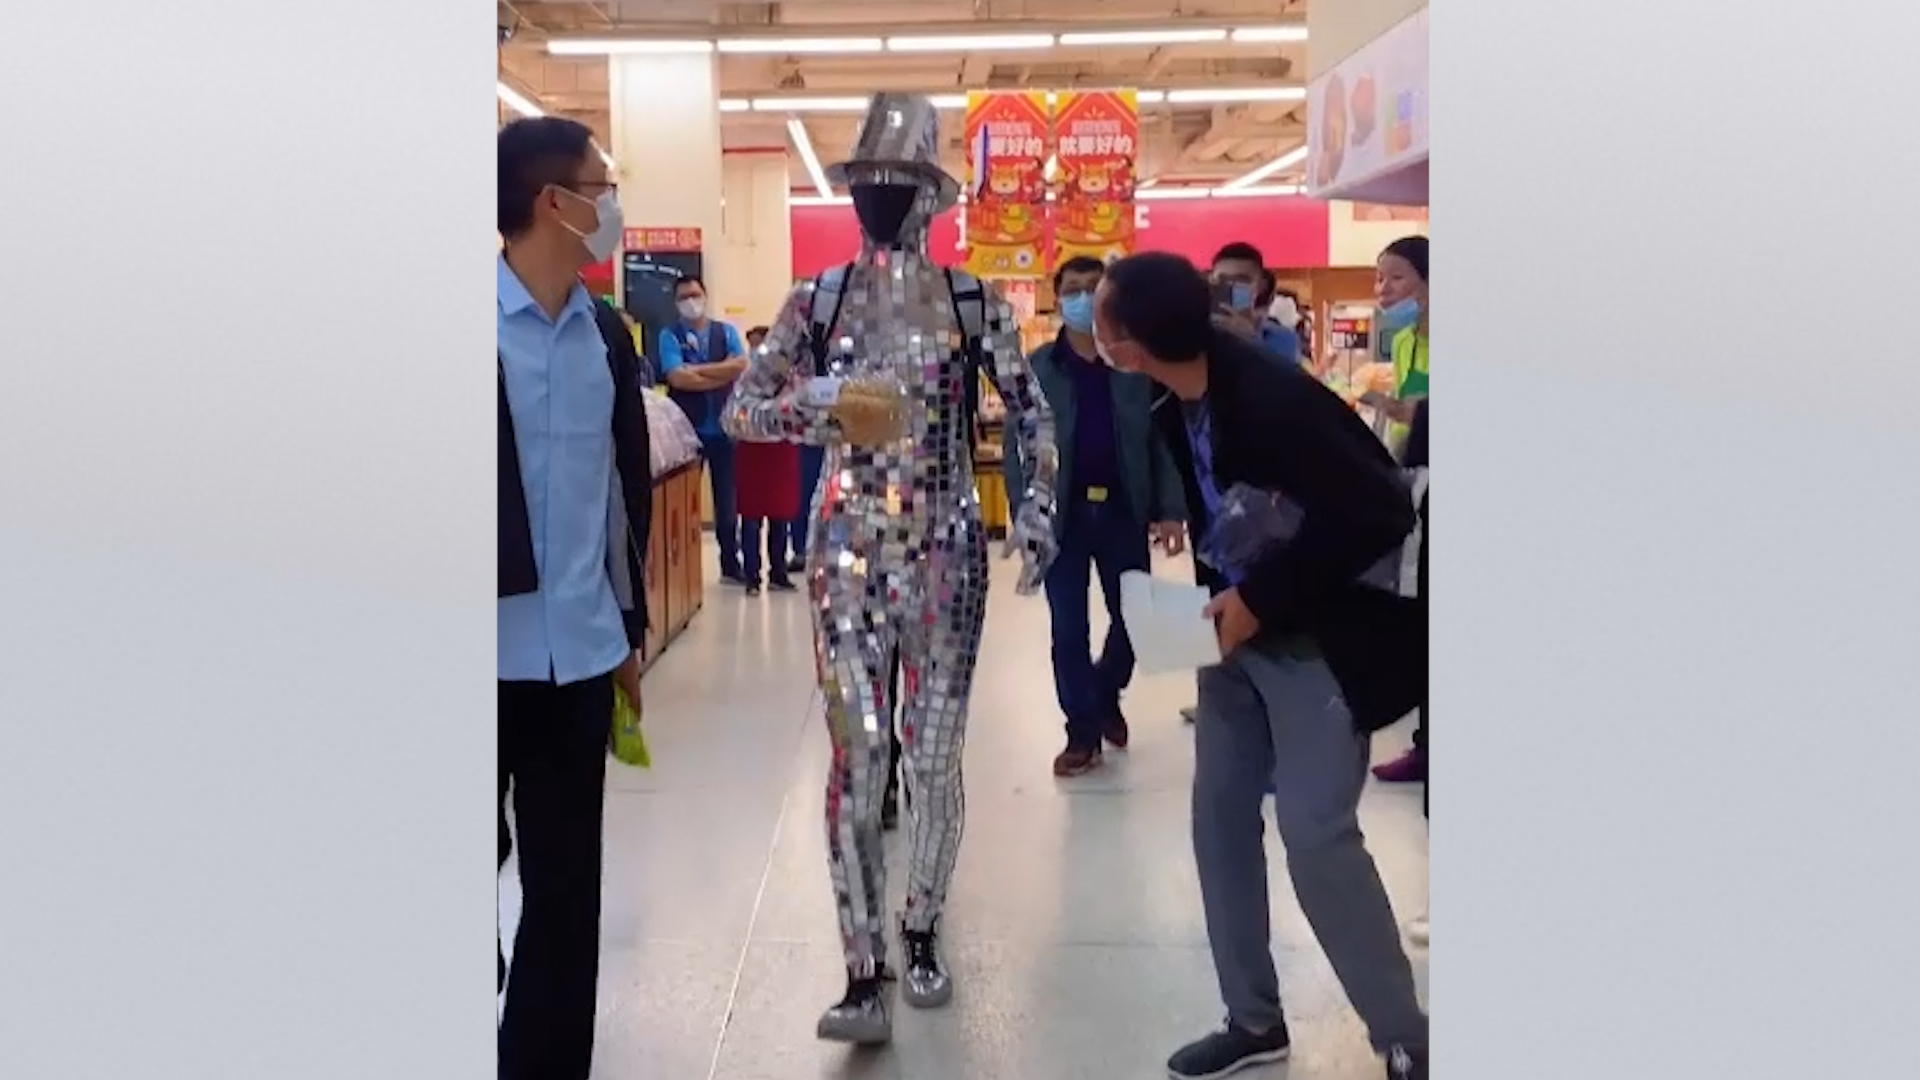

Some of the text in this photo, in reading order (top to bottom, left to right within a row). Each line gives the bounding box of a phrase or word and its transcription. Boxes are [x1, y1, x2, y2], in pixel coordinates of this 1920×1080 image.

[971, 136, 1043, 156] 要好的
[1059, 134, 1133, 156] 就要好的
